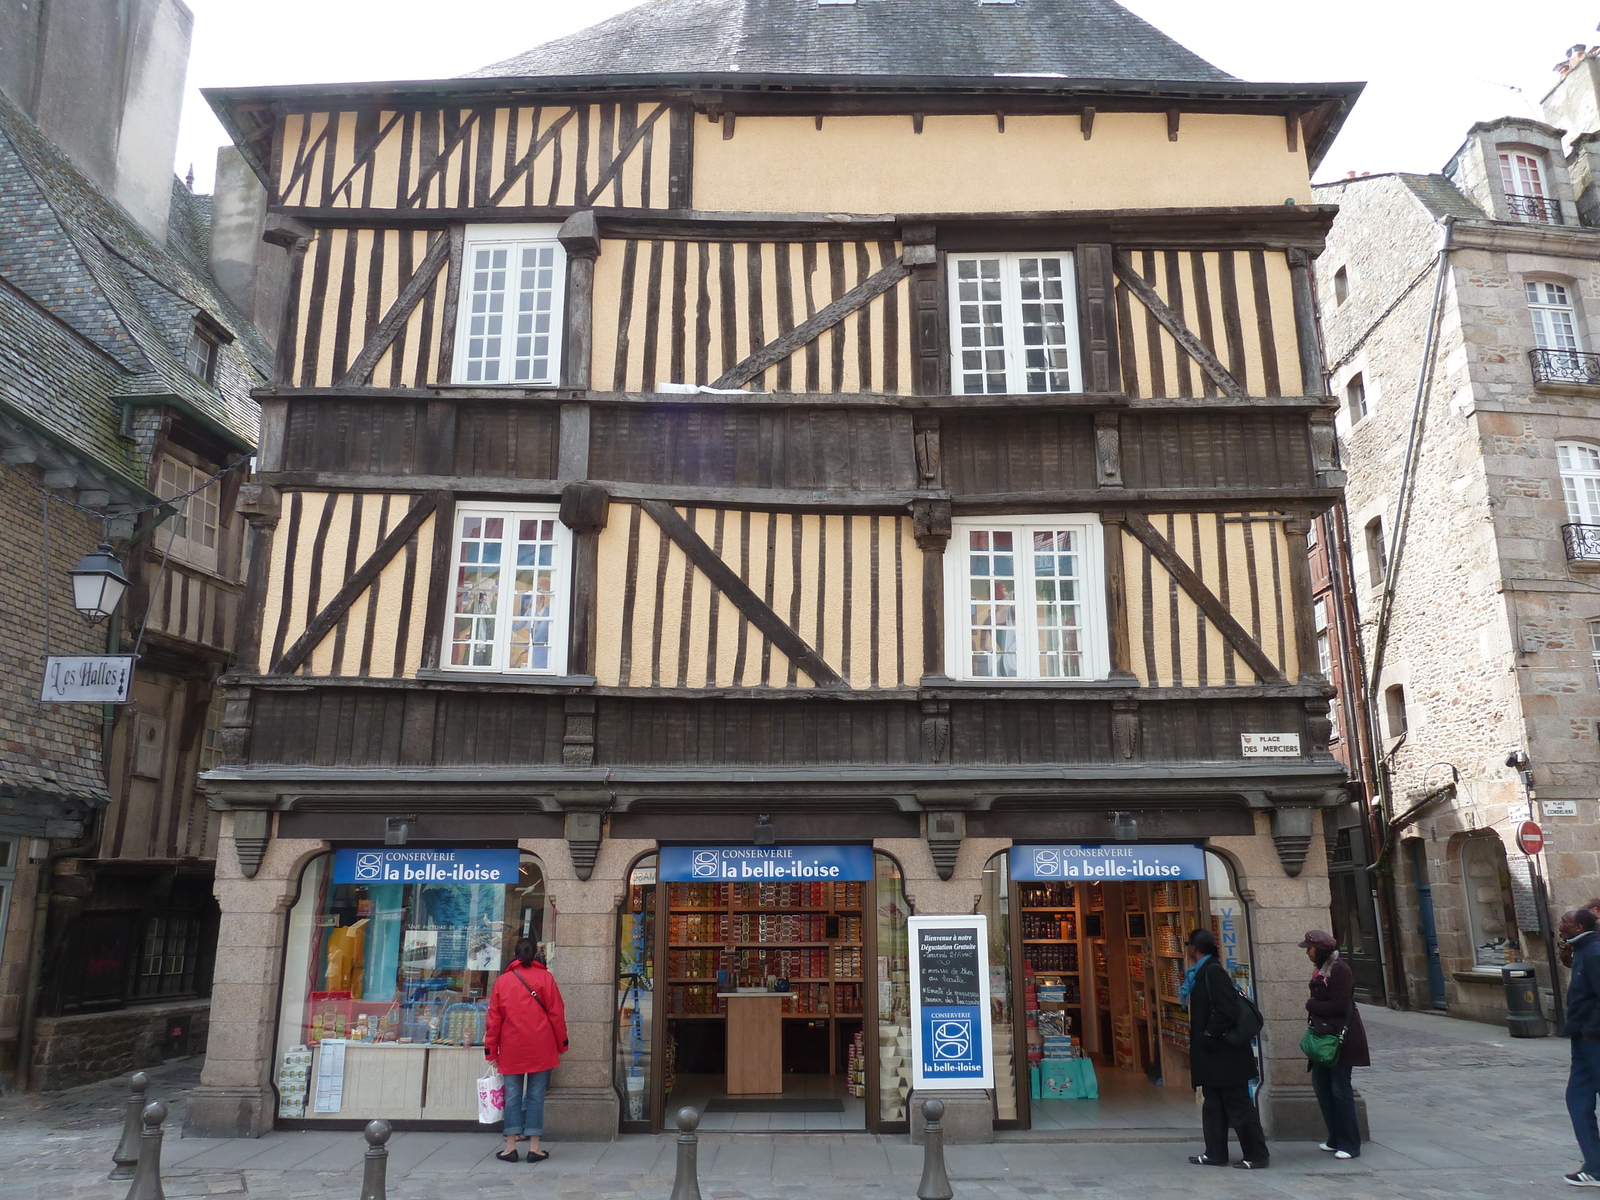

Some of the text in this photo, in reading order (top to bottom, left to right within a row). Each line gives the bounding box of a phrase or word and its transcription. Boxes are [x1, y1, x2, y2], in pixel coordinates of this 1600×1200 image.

[50, 662, 118, 695] Les Halles
[385, 852, 456, 861] CONSERVERIE
[721, 849, 793, 859] CONSERVERIE
[1062, 848, 1134, 857] CONSERVERIE
[384, 863, 500, 881] la belle-iloise
[722, 860, 840, 878] la belle-iloise
[1063, 859, 1181, 877] la belle-iloise
[632, 912, 644, 974] VENTE
[952, 933, 957, 941] à
[1220, 908, 1238, 970] VENTE
[920, 943, 953, 954] Dégustation
[630, 988, 644, 1077] DIRECTE
[924, 1062, 981, 1072] la belle-iloise
